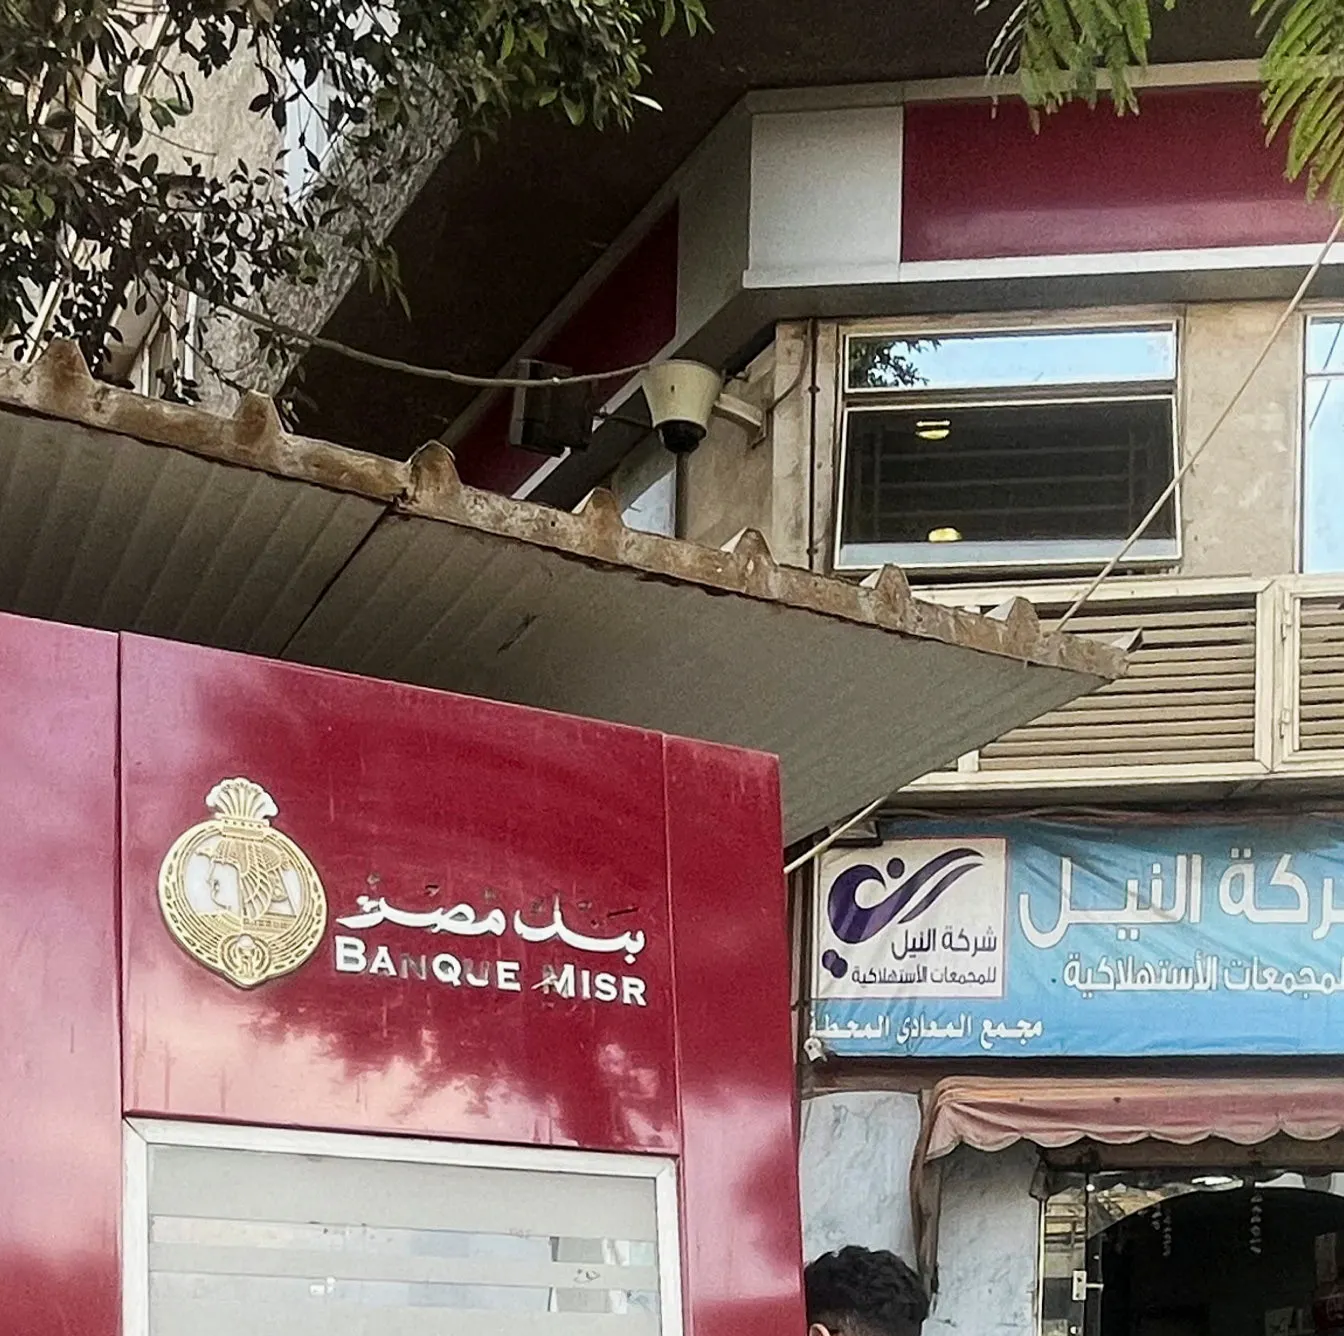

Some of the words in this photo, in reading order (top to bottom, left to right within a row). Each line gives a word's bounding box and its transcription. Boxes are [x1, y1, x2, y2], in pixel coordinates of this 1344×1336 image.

[1018, 852, 1204, 949] النيل
[890, 927, 937, 961] النيل
[941, 925, 998, 957] شركة
[334, 934, 522, 991] BANQUE
[533, 963, 648, 1006] MISR
[930, 965, 997, 985] للمجمعات
[980, 1016, 1044, 1050] مجمع
